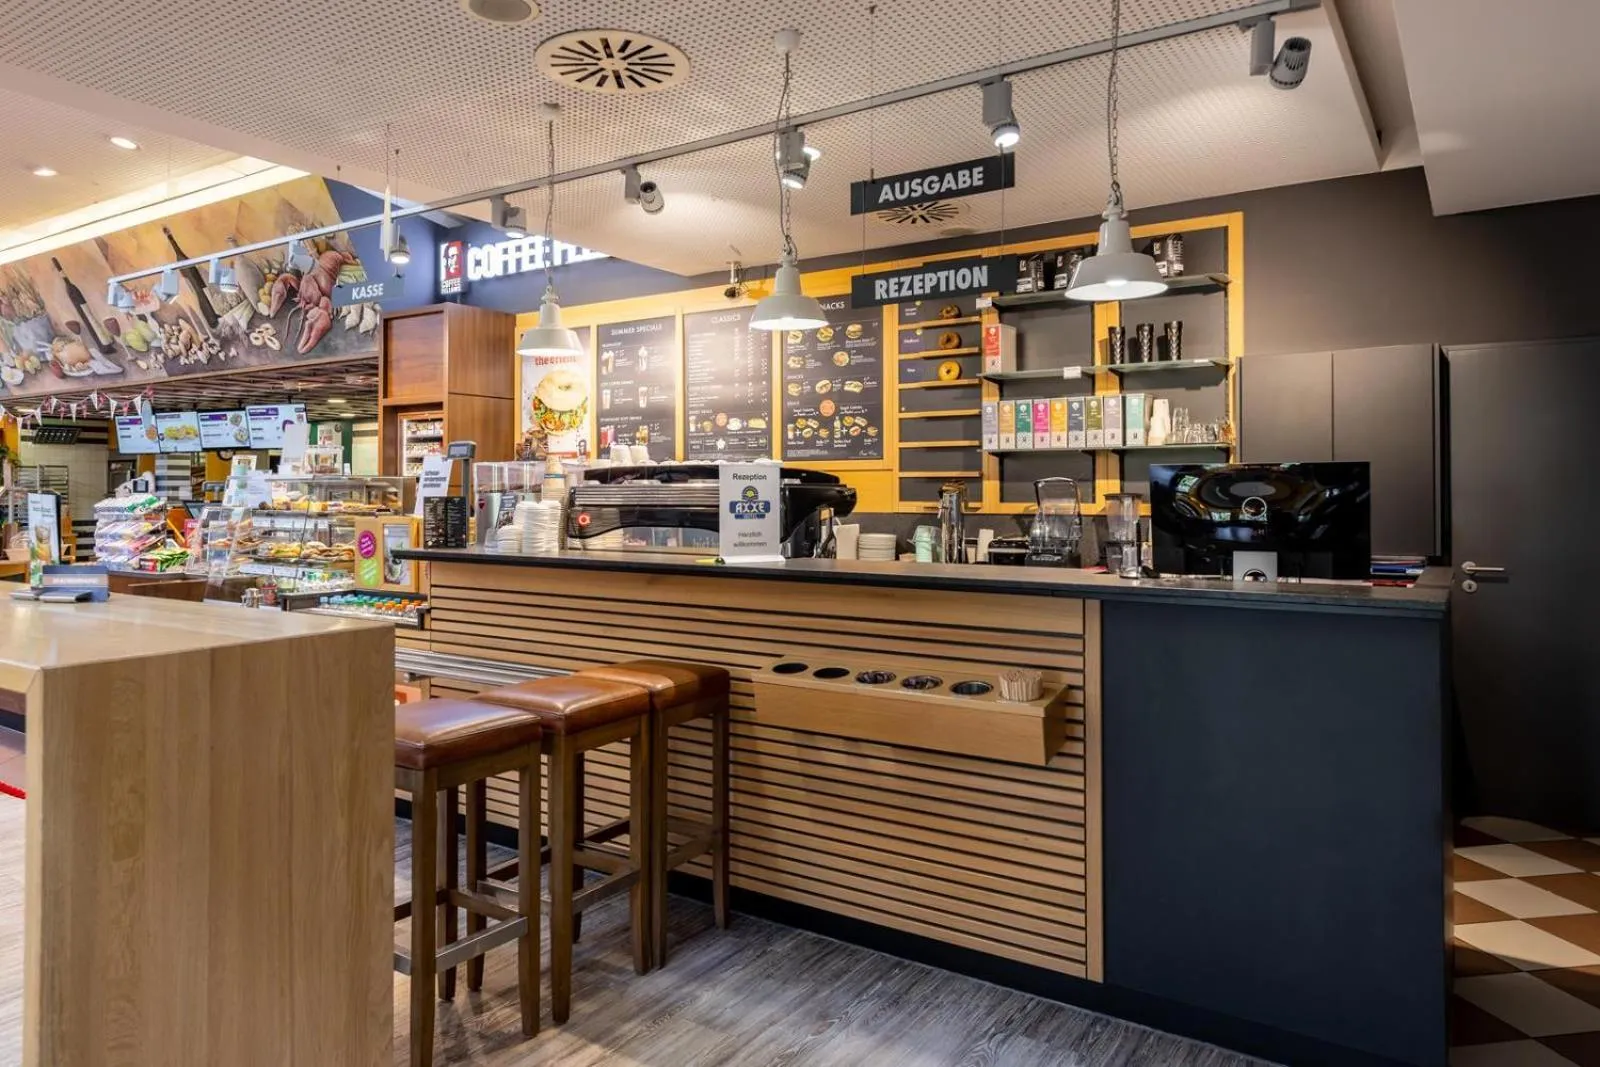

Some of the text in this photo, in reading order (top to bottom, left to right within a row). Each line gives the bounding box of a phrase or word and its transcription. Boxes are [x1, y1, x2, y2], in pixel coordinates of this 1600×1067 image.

[878, 166, 984, 204] AUSGABE
[467, 236, 553, 281] COFFEE
[874, 265, 989, 300] REZEPTION
[351, 283, 384, 300] KASSE
[820, 301, 845, 310] NACKS
[711, 313, 741, 324] CLASSICS
[732, 473, 767, 482] Rezeption
[735, 501, 766, 513] AXXE
